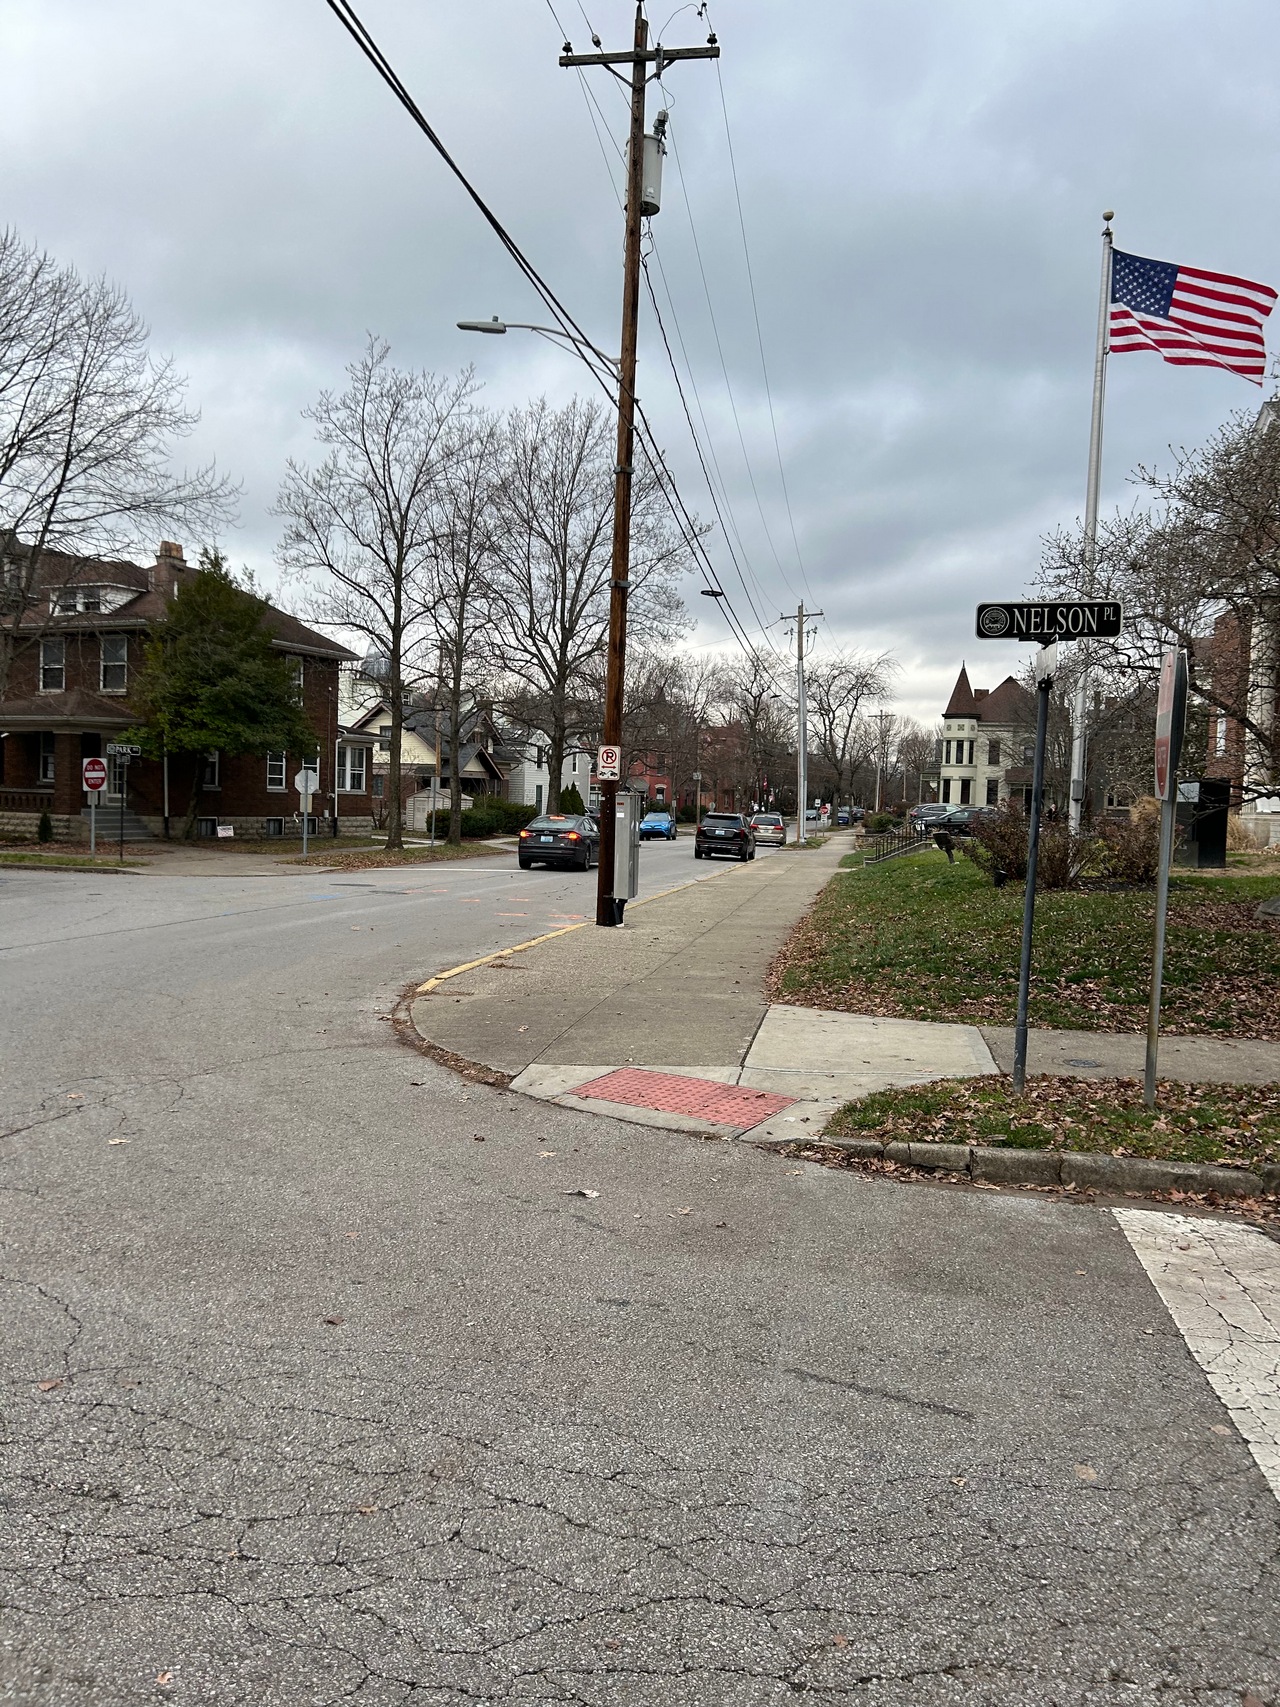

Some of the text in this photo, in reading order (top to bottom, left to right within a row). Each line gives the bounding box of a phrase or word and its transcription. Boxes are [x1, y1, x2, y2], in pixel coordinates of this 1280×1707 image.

[1012, 606, 1099, 634] NELSON
[1103, 606, 1117, 621] PL
[115, 746, 131, 754] PARK
